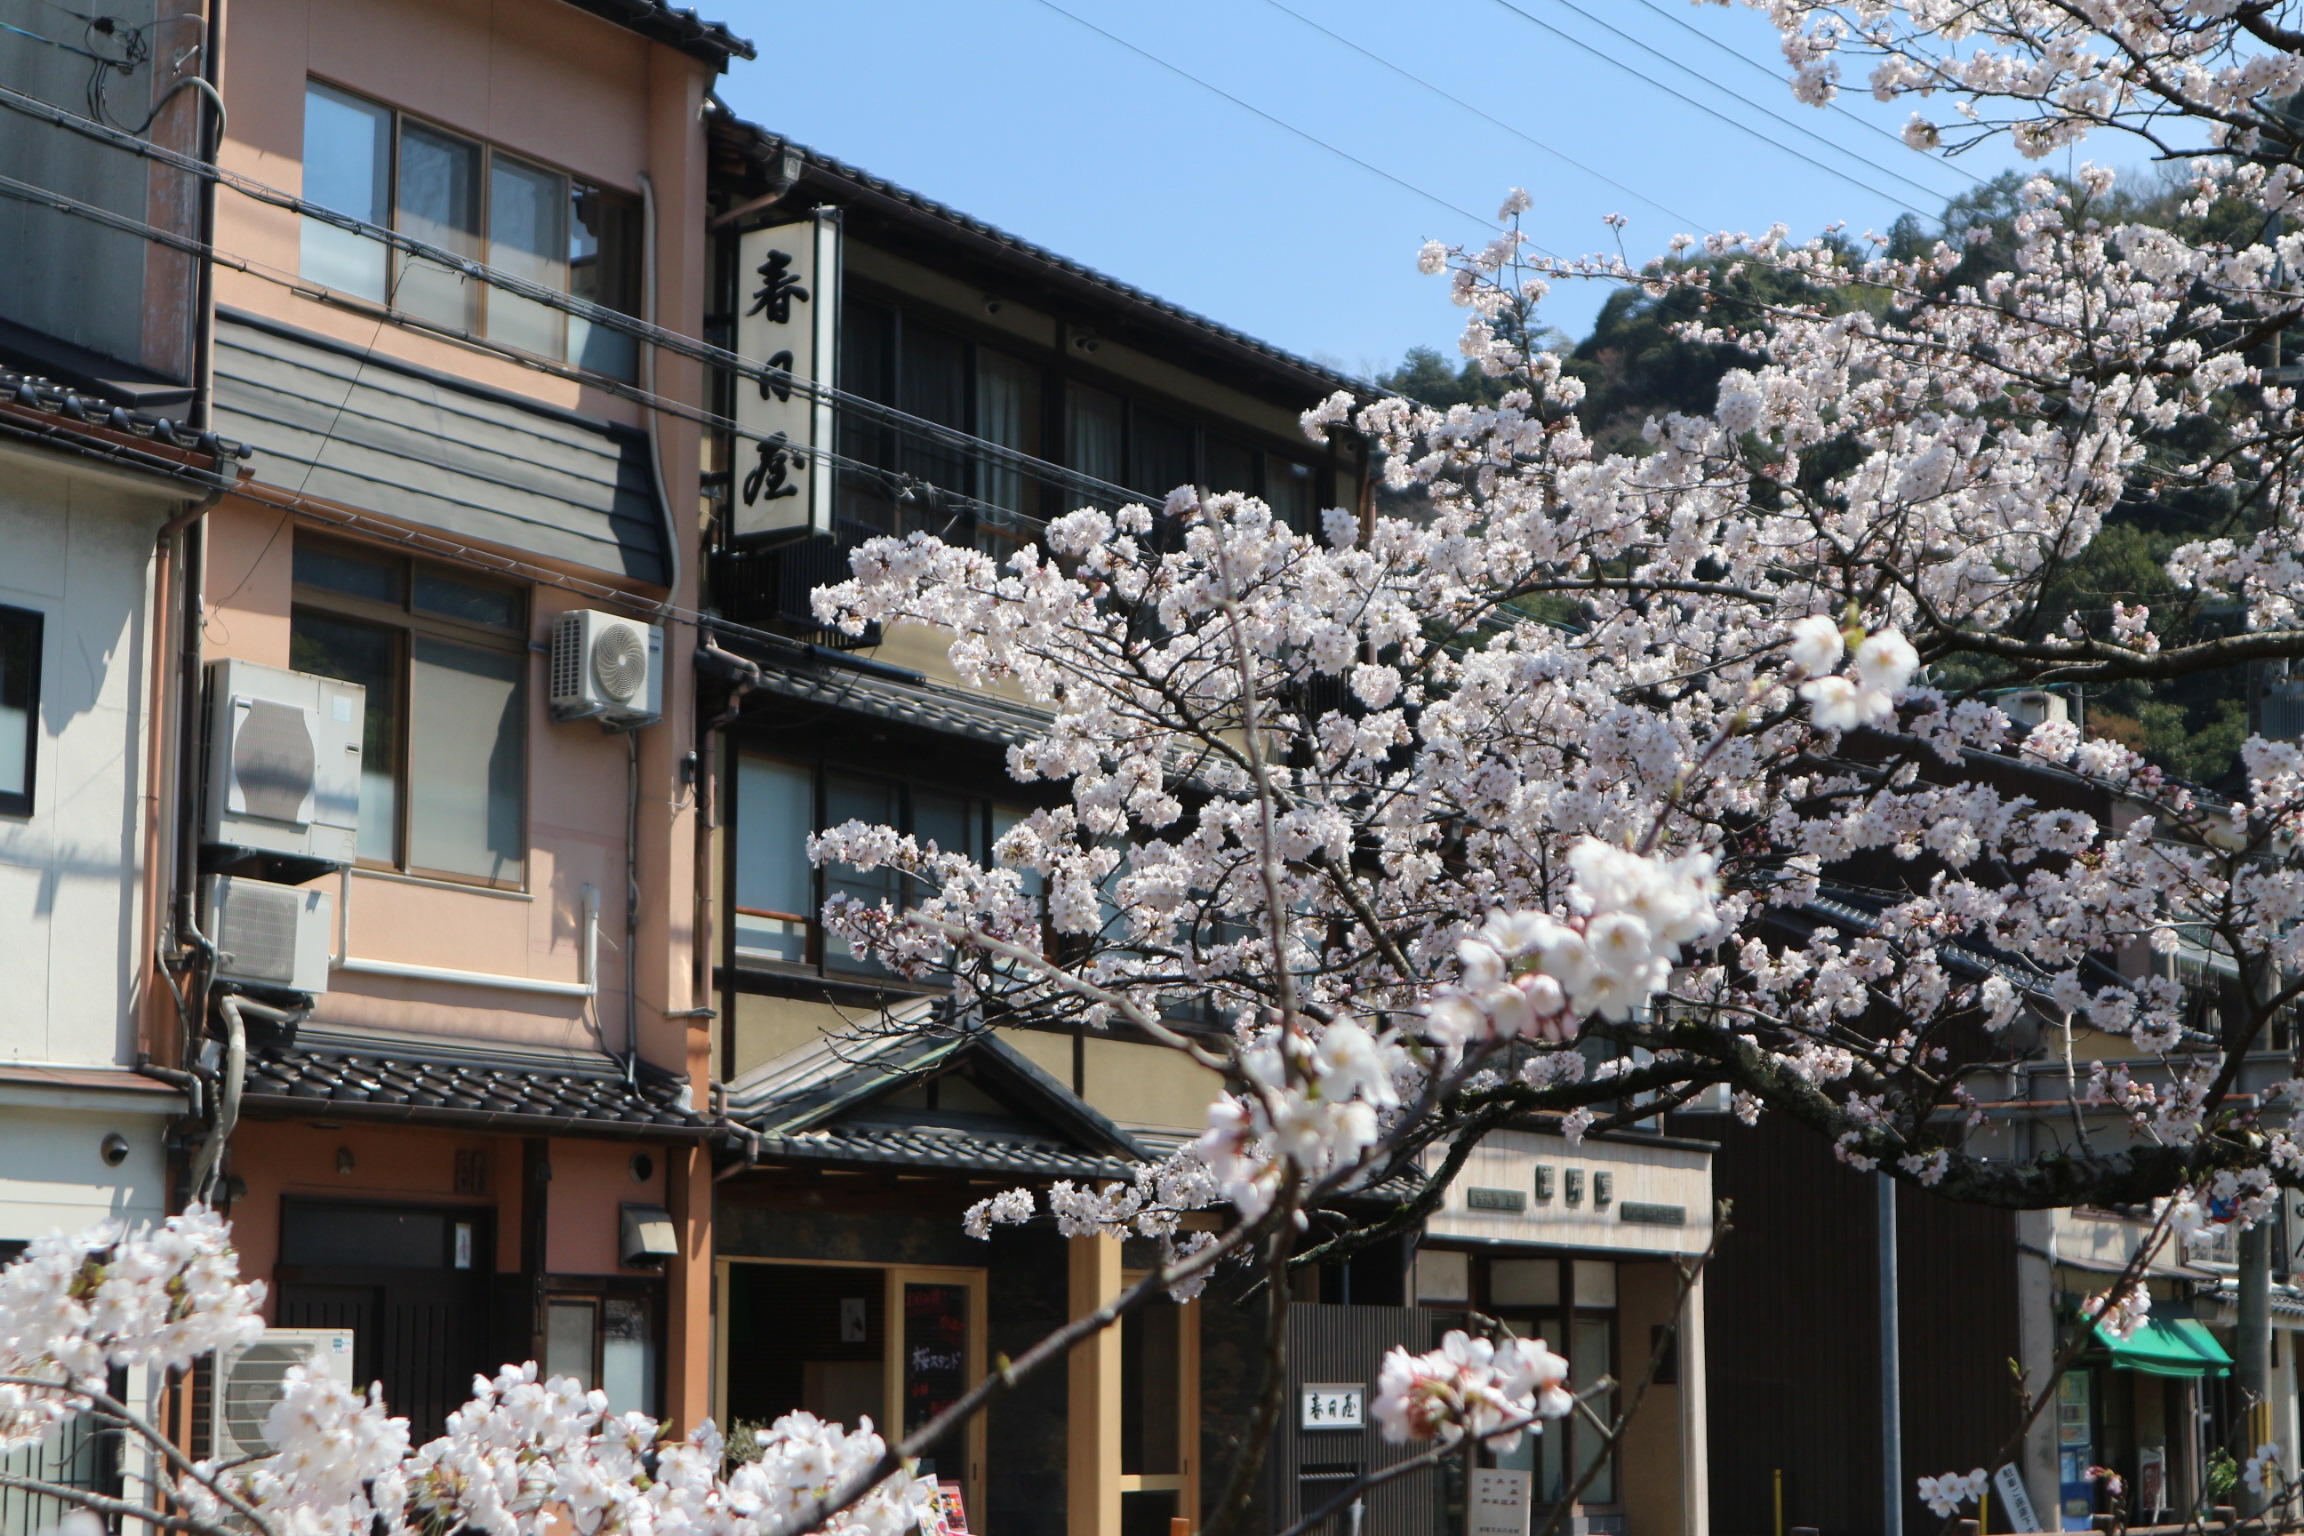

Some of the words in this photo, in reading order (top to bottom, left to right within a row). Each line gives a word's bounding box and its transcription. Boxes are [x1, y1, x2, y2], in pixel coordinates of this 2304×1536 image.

[744, 249, 810, 507] 春日屋
[1310, 1392, 1356, 1420] 春日屋
